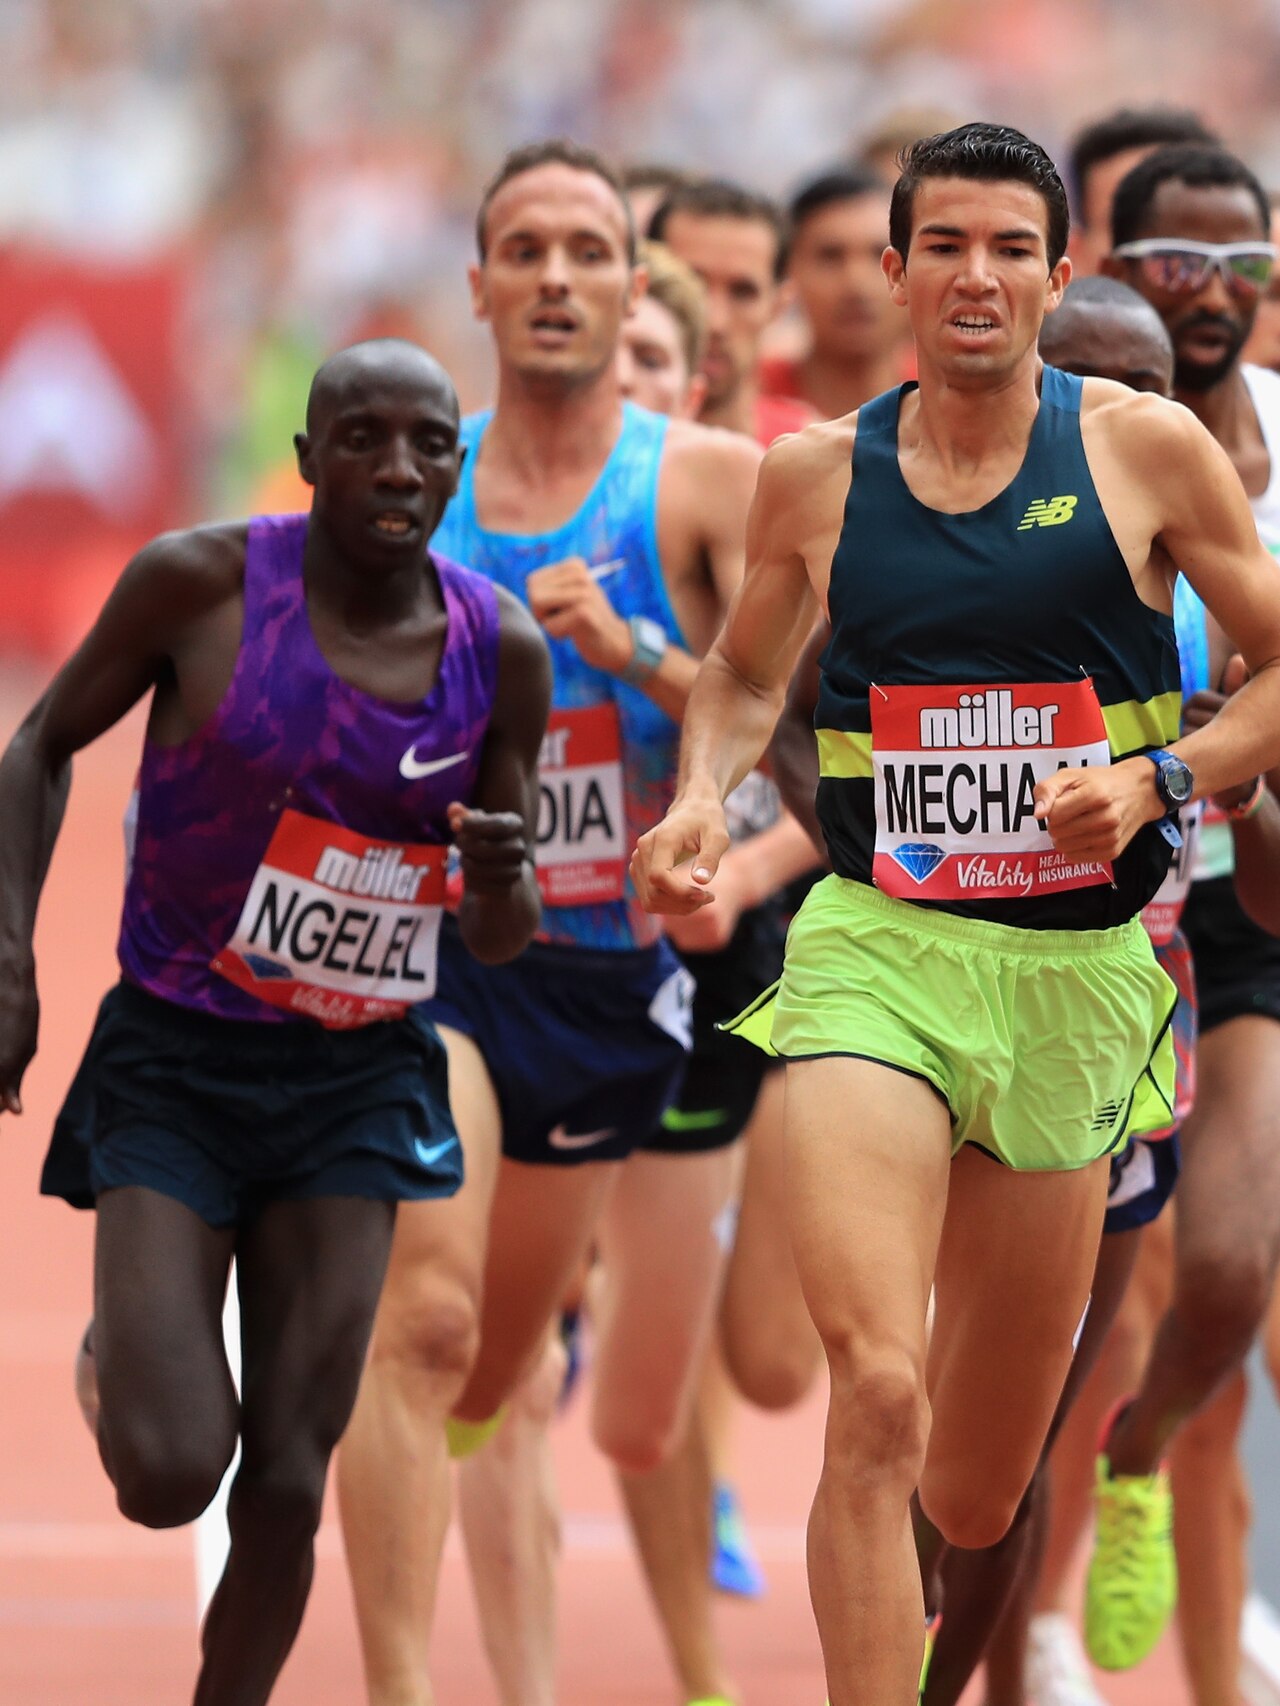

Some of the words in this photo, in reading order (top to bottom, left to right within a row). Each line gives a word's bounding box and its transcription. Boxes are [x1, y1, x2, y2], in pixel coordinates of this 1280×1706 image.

[919, 689, 1059, 748] müller
[883, 758, 1089, 835] MECHA
[312, 844, 430, 901] müller
[957, 854, 1034, 896] Vitality
[1039, 853, 1066, 869] HEAL
[247, 881, 426, 982] NGELEL
